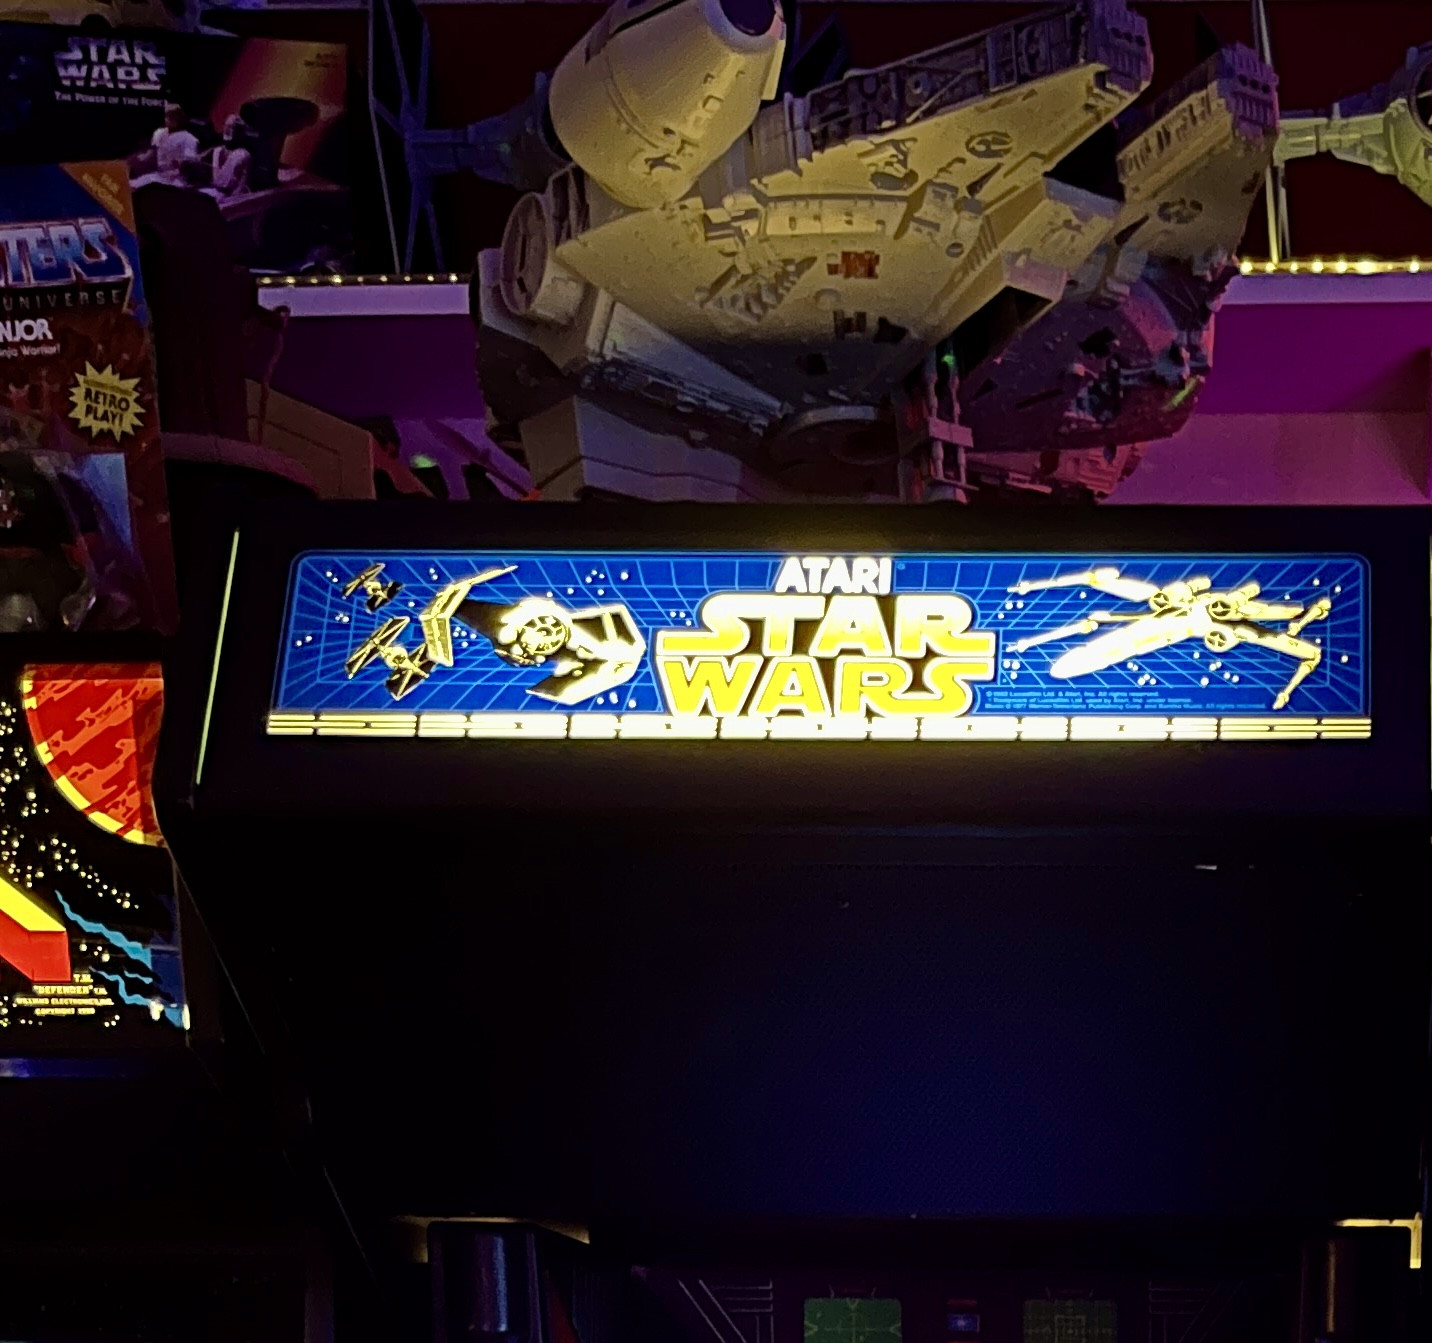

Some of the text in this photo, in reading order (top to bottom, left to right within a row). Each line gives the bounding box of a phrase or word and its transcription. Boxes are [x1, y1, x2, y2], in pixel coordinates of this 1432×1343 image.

[54, 36, 166, 66] STAR
[56, 65, 166, 91] WARS
[2, 289, 122, 311] UNIVERSE
[0, 318, 54, 342] NJOR
[84, 388, 130, 412] RETRO
[85, 406, 124, 427] PLAY!
[775, 556, 892, 595] ATARI
[655, 590, 997, 657] STAR
[659, 655, 997, 719] WARS
